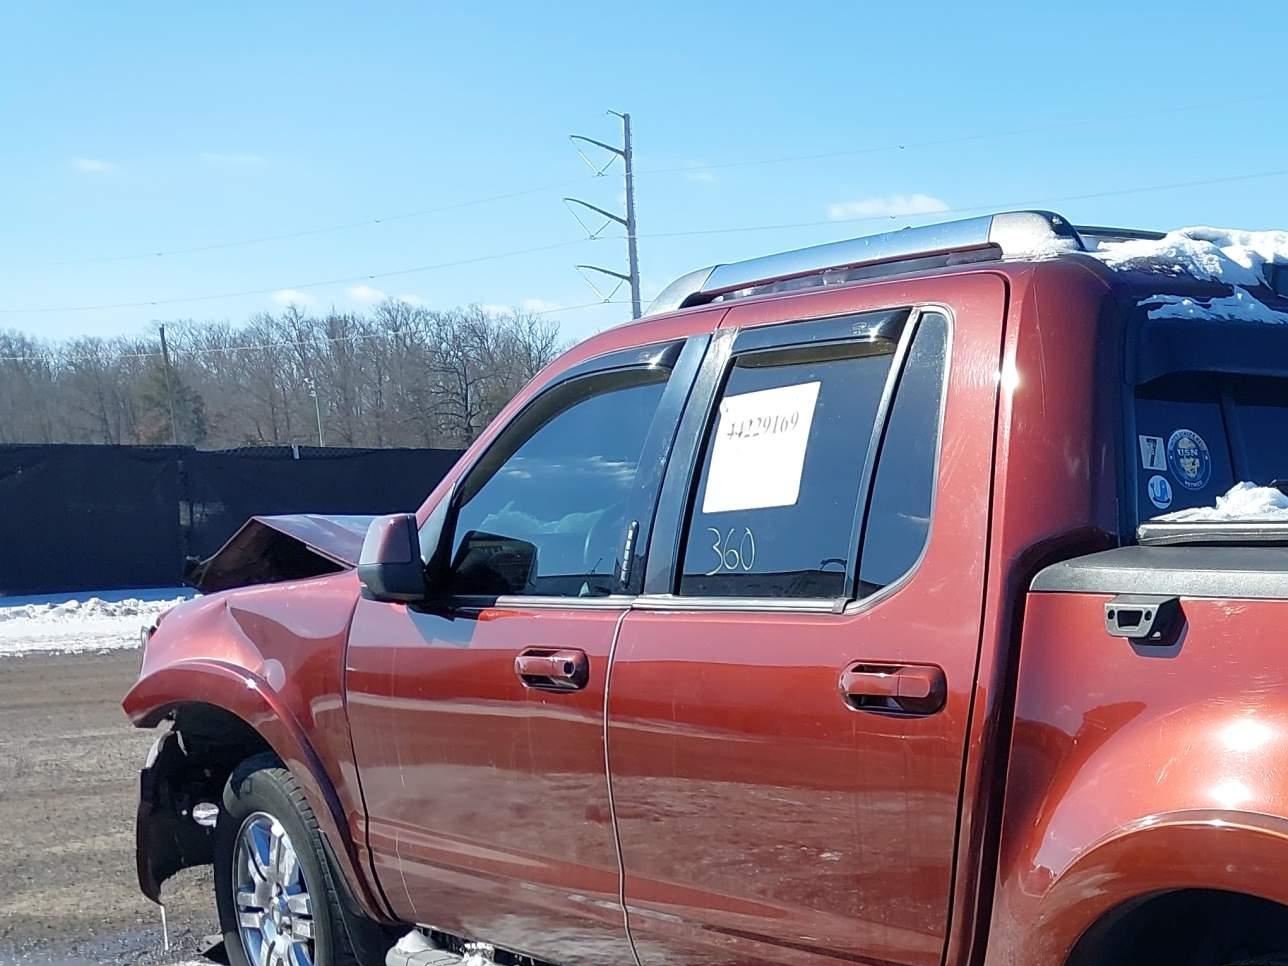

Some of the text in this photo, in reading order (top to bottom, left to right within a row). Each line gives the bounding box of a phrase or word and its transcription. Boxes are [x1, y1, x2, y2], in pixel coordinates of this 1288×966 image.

[725, 410, 800, 440] 44229169
[1177, 447, 1199, 457] USN
[705, 526, 756, 577] 360
